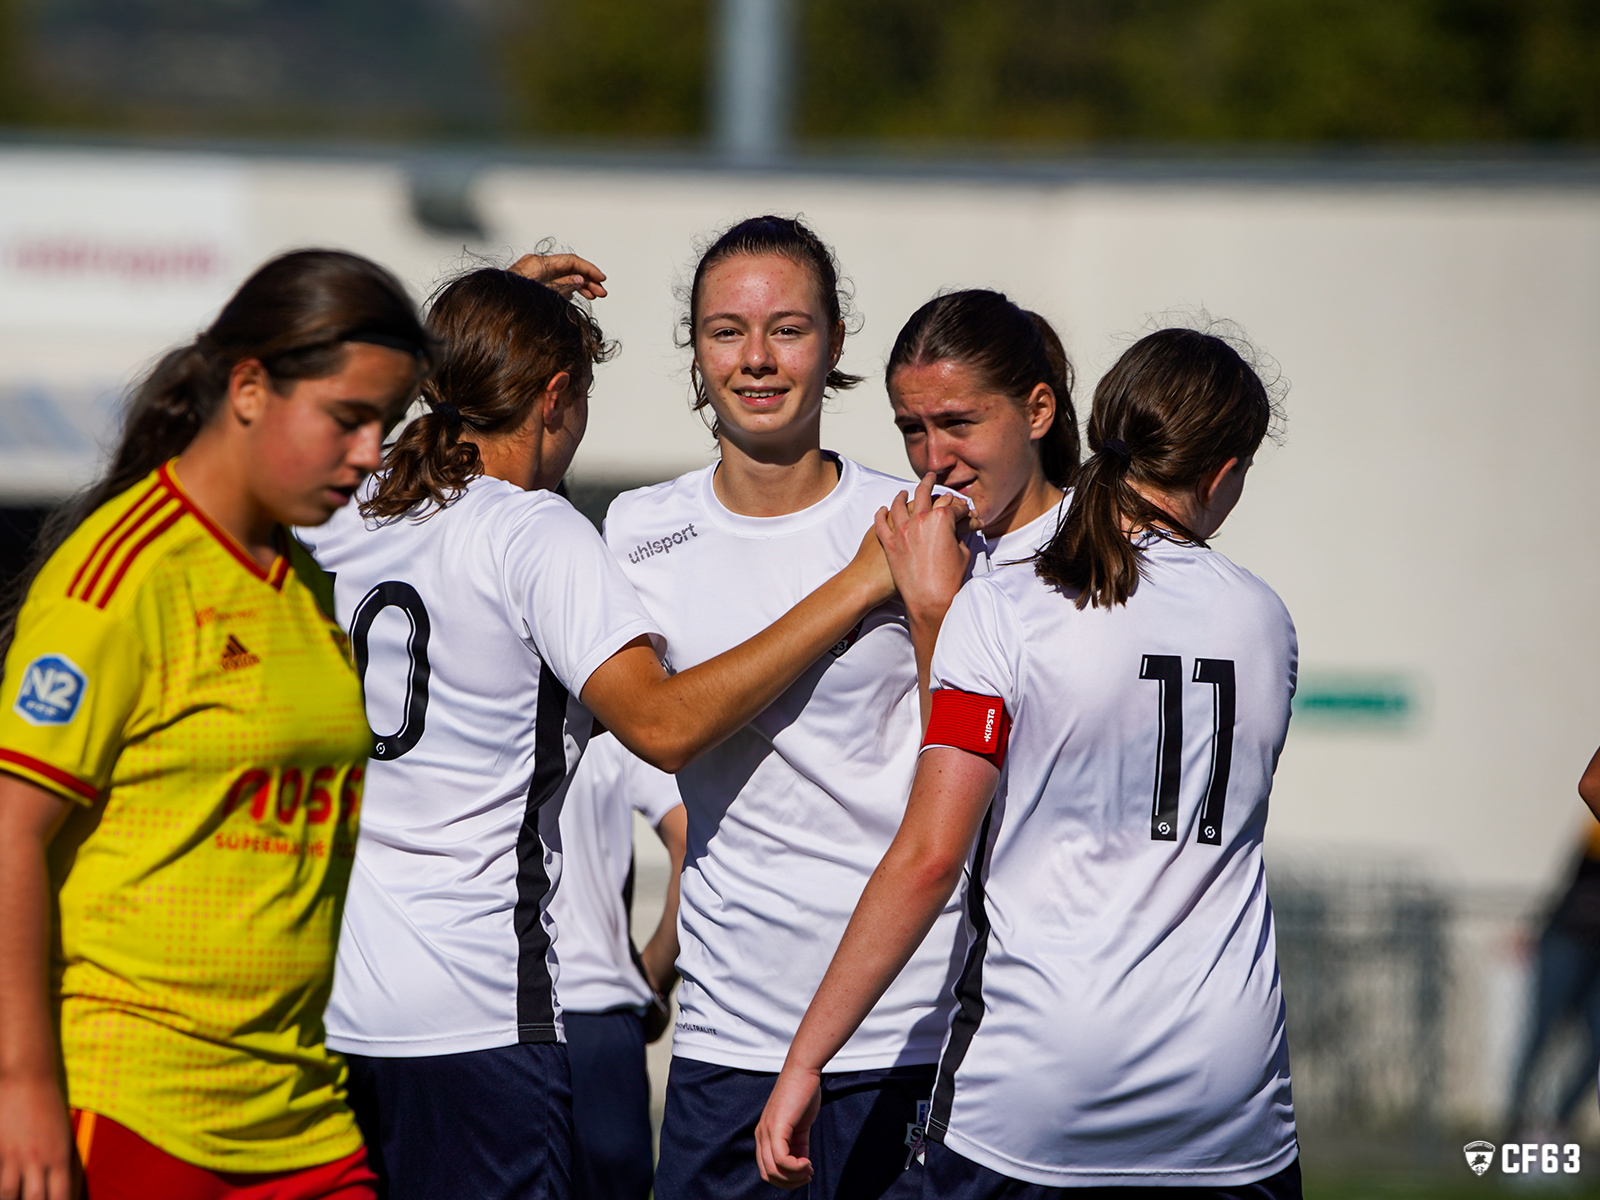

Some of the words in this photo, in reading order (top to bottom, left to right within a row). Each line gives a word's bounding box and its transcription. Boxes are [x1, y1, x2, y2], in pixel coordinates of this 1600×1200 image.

[628, 523, 698, 565] uhlsport
[21, 666, 77, 711] N2
[322, 571, 430, 761] 0
[984, 708, 996, 740] KIPSTA
[1139, 654, 1236, 846] 11
